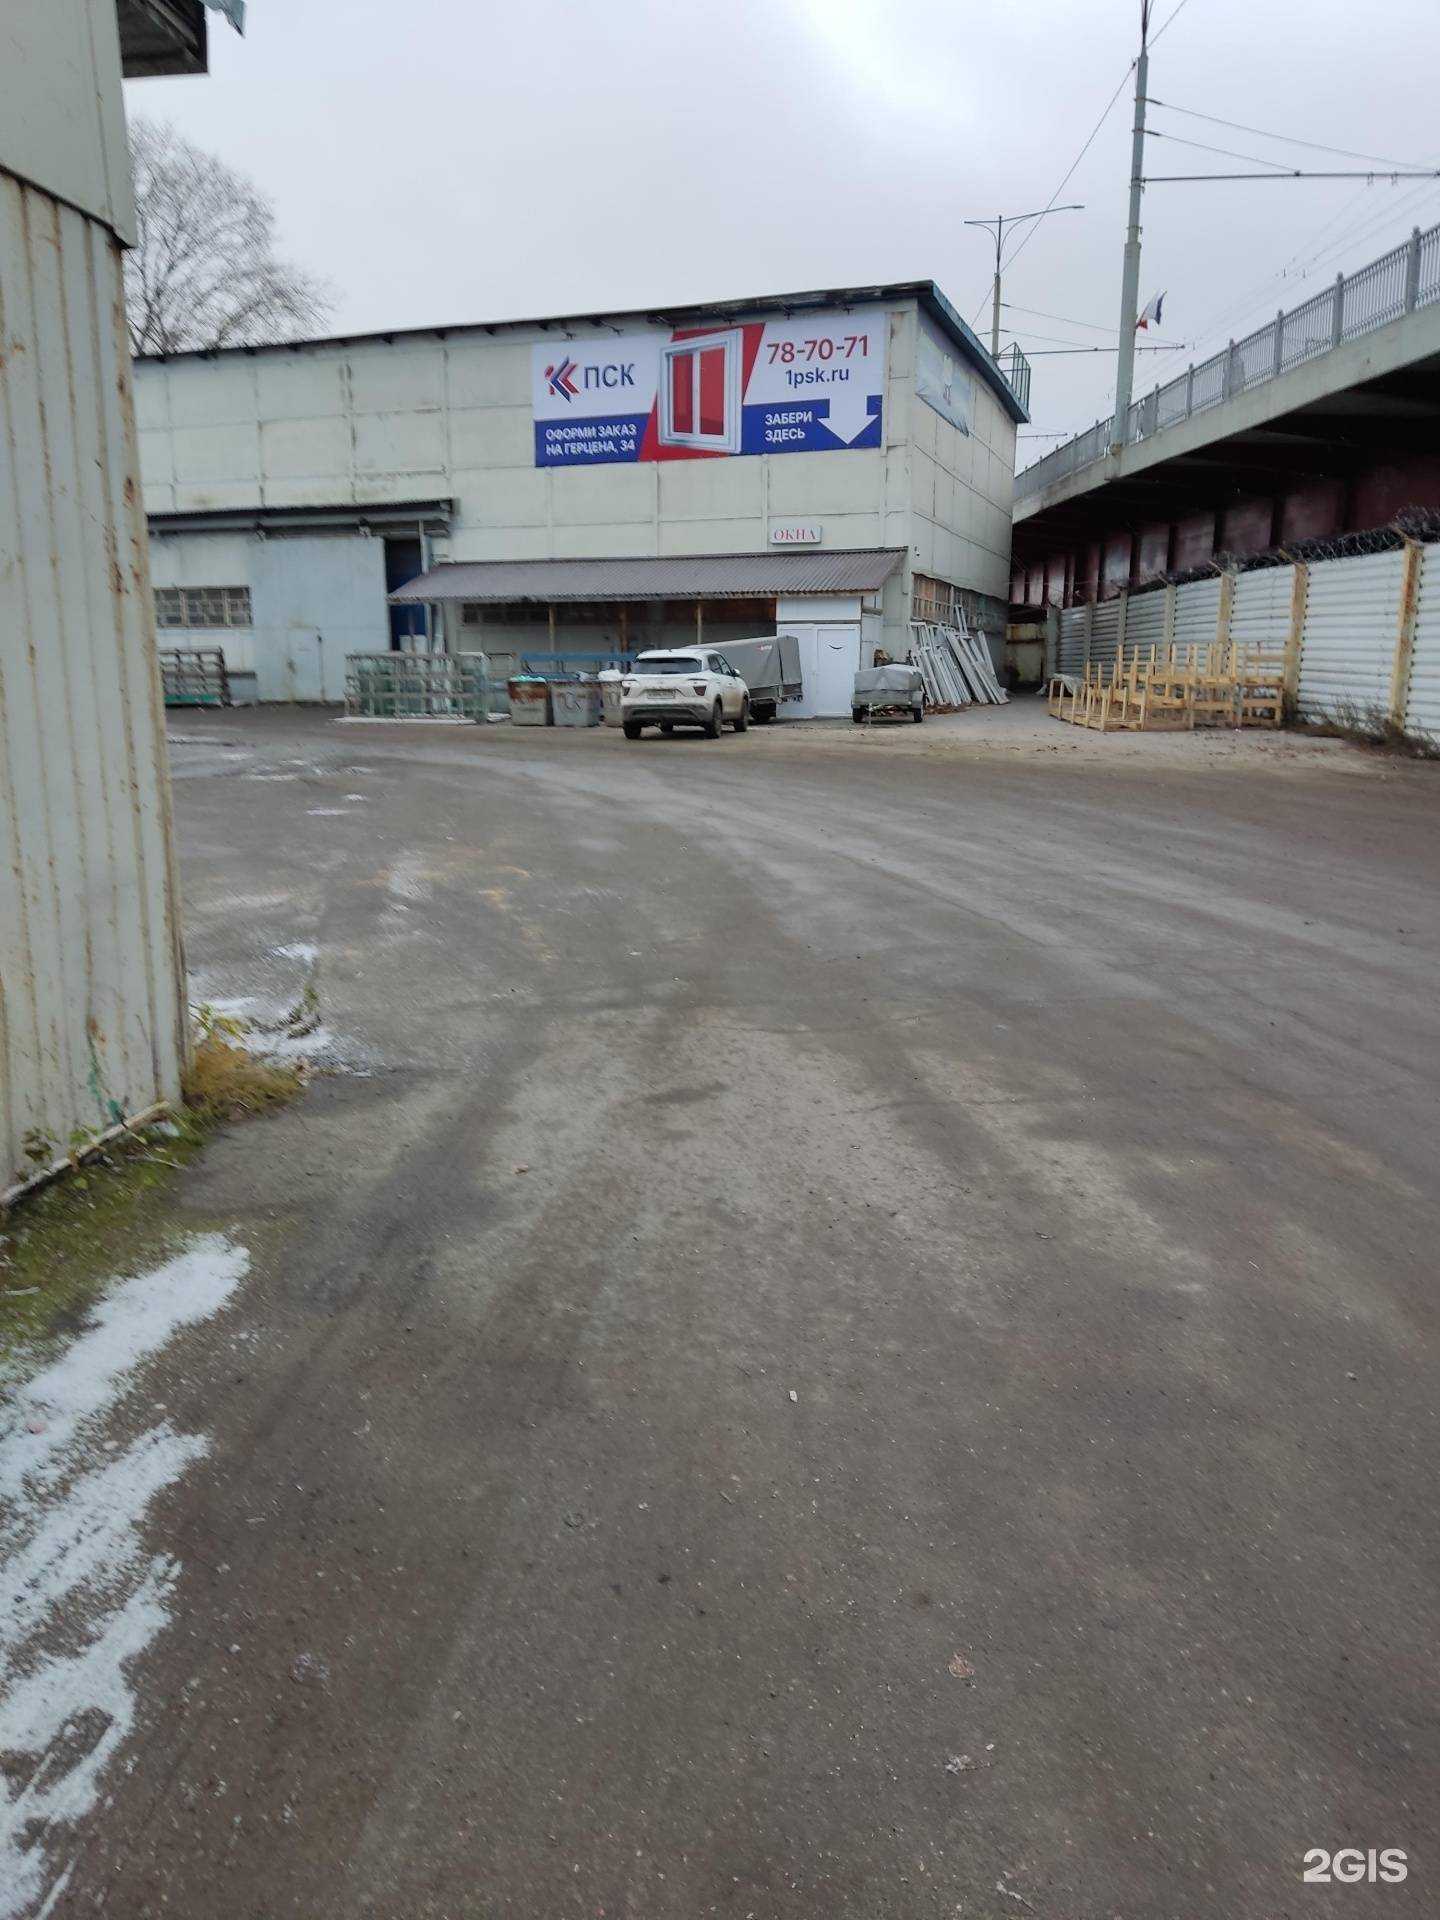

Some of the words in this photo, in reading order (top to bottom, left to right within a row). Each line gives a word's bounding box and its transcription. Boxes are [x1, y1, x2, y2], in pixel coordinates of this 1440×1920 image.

[766, 335, 869, 365] 78-70-71
[583, 363, 635, 389] ПСК
[785, 366, 850, 389] 1psk.ru
[764, 411, 813, 426] ЗАБЕРИ
[545, 426, 597, 441] ОФОРМИ
[598, 423, 638, 438] ЗАКАЗ
[764, 428, 806, 443] ЗДЕСЬ
[545, 443, 563, 456] НА
[564, 440, 618, 455] ГЕРЦЕНА,
[620, 439, 636, 452] 34
[774, 529, 817, 540] ОКНА
